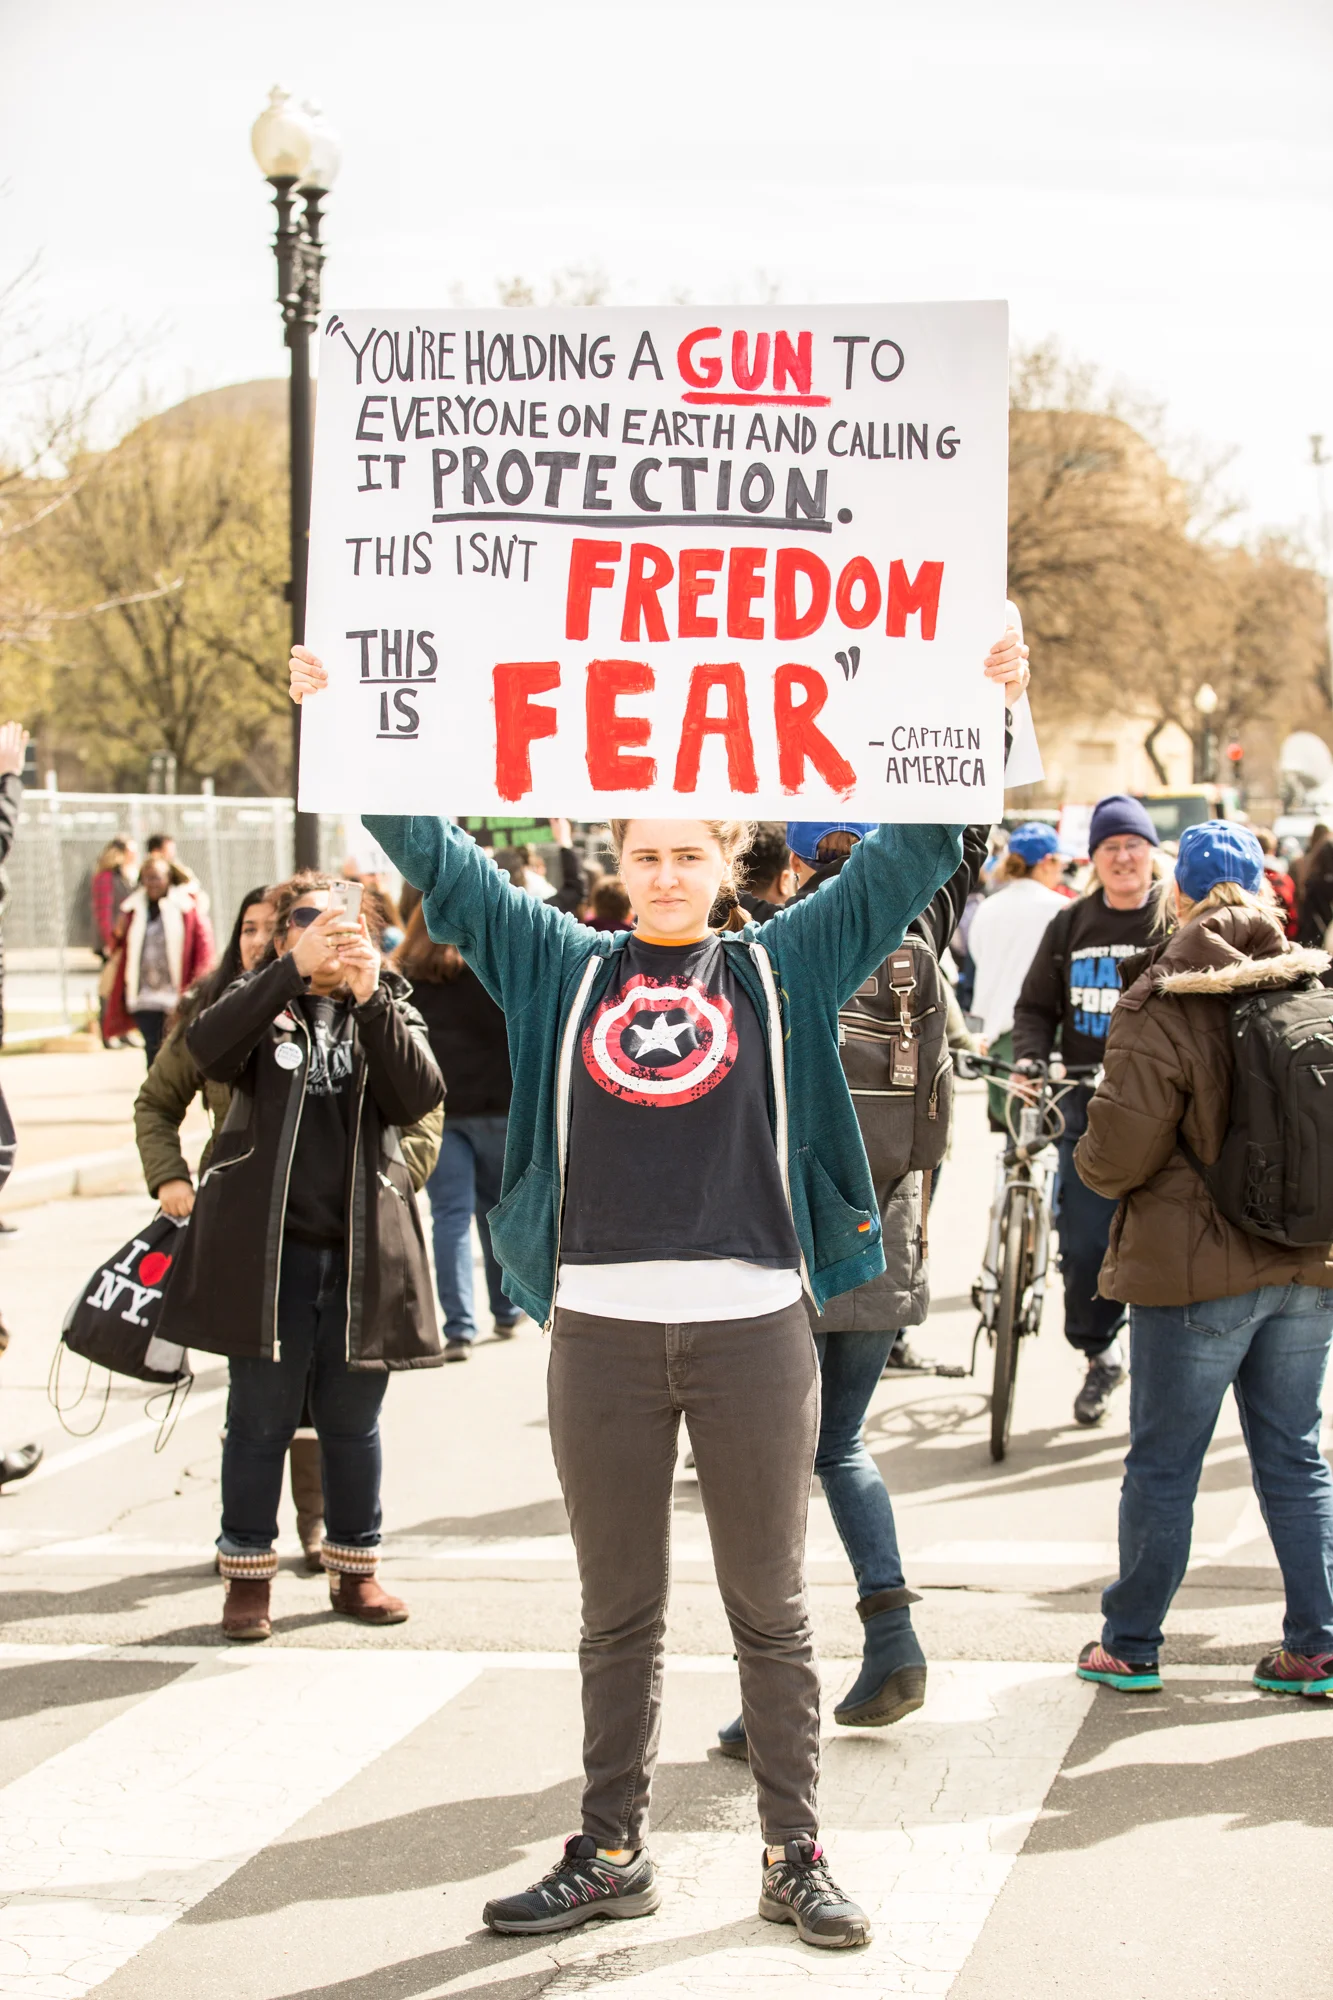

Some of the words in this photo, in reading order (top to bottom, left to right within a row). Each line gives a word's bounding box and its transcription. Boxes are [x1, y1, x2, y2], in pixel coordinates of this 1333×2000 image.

[466, 330, 616, 385] HOLDING
[628, 330, 664, 381] A
[677, 326, 813, 394] GUN
[833, 336, 905, 390] TO
[356, 395, 548, 442] EVERYONE
[558, 403, 610, 438] ON
[622, 408, 735, 450] EARTH
[746, 413, 817, 455] AND
[827, 420, 961, 461] CALLING
[357, 454, 406, 492] IT
[432, 446, 853, 524] PROTECTION.
[345, 531, 433, 577] THIS
[456, 532, 538, 582] ISN'T
[565, 538, 945, 642] FREEDOM
[345, 629, 439, 678] THIS
[379, 688, 420, 733] IS
[886, 756, 986, 787] AMERICA
[114, 1239, 150, 1275] I
